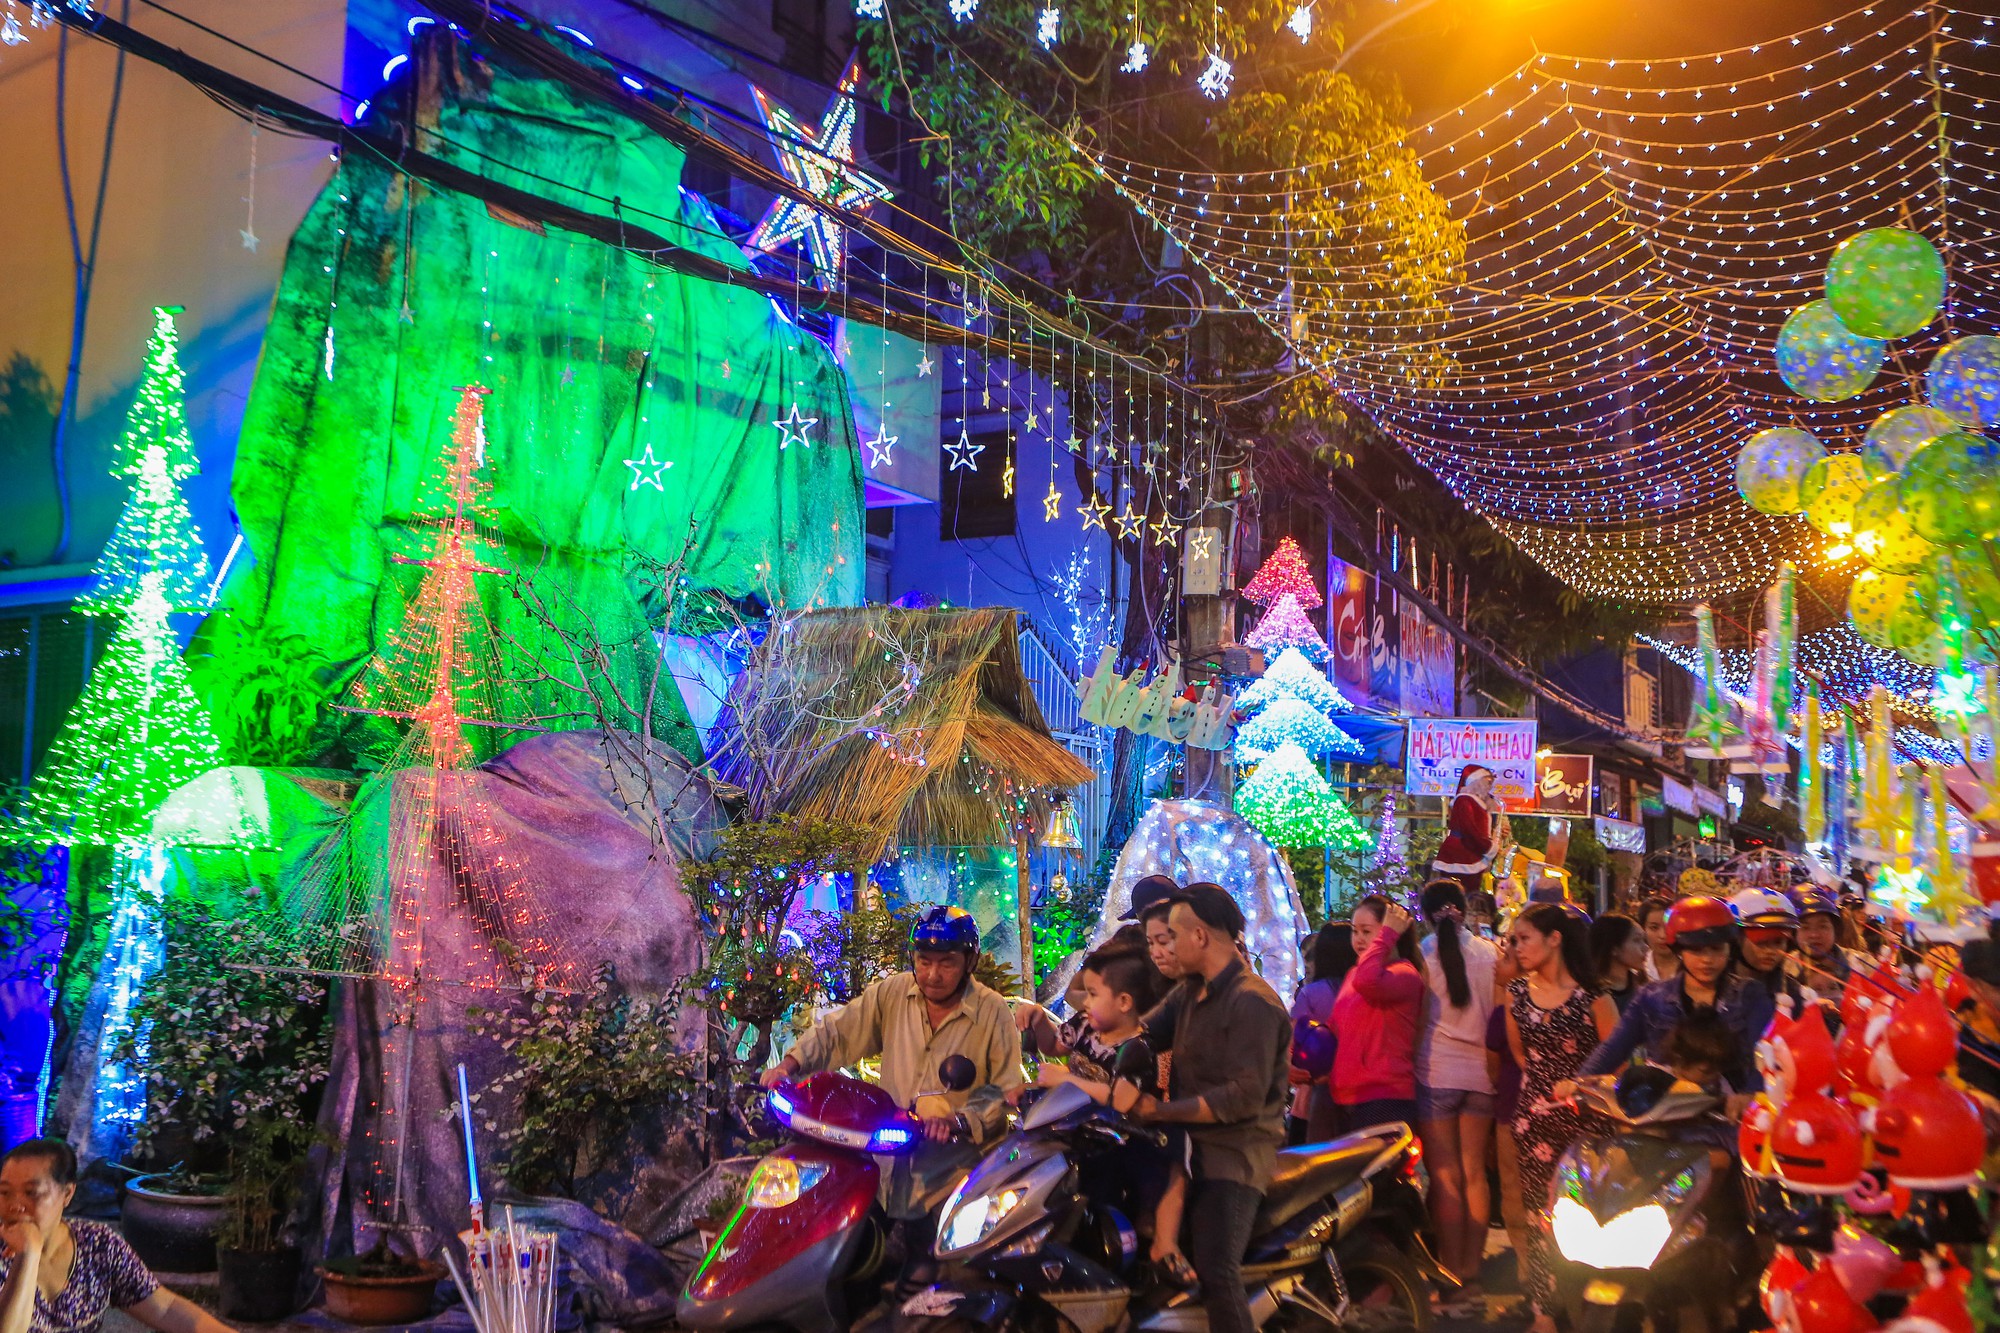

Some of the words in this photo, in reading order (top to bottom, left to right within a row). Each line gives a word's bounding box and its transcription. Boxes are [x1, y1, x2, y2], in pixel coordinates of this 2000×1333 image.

[1412, 723, 1445, 758] HÁT
[1449, 725, 1480, 760] VỚI
[1485, 731, 1533, 760] NHAU
[1419, 766, 1449, 778] Thứ
[1503, 768, 1525, 779] CN
[1493, 784, 1525, 795] 22h
